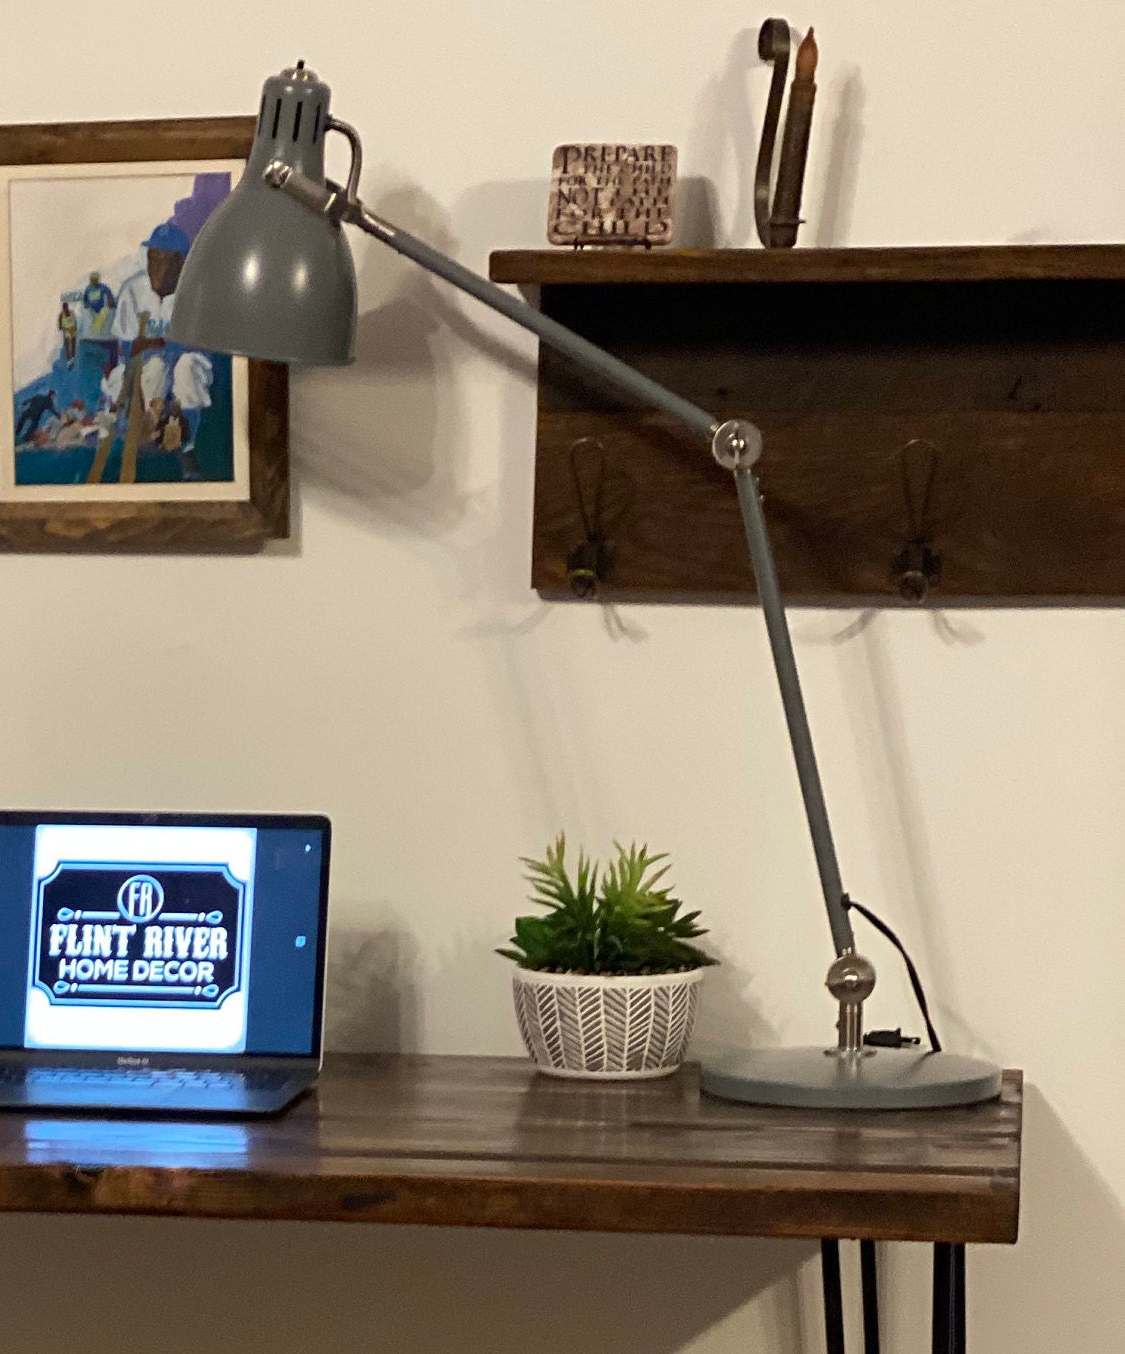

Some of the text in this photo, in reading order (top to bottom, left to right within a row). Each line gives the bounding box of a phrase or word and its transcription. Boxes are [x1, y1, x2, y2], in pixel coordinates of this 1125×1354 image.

[560, 145, 672, 174] PREPARE
[558, 175, 587, 186] FOR
[557, 186, 603, 206] NOT
[552, 219, 669, 236] CHILD
[48, 923, 229, 960] FLINT RIVER
[58, 958, 215, 983] HOME DECOR
